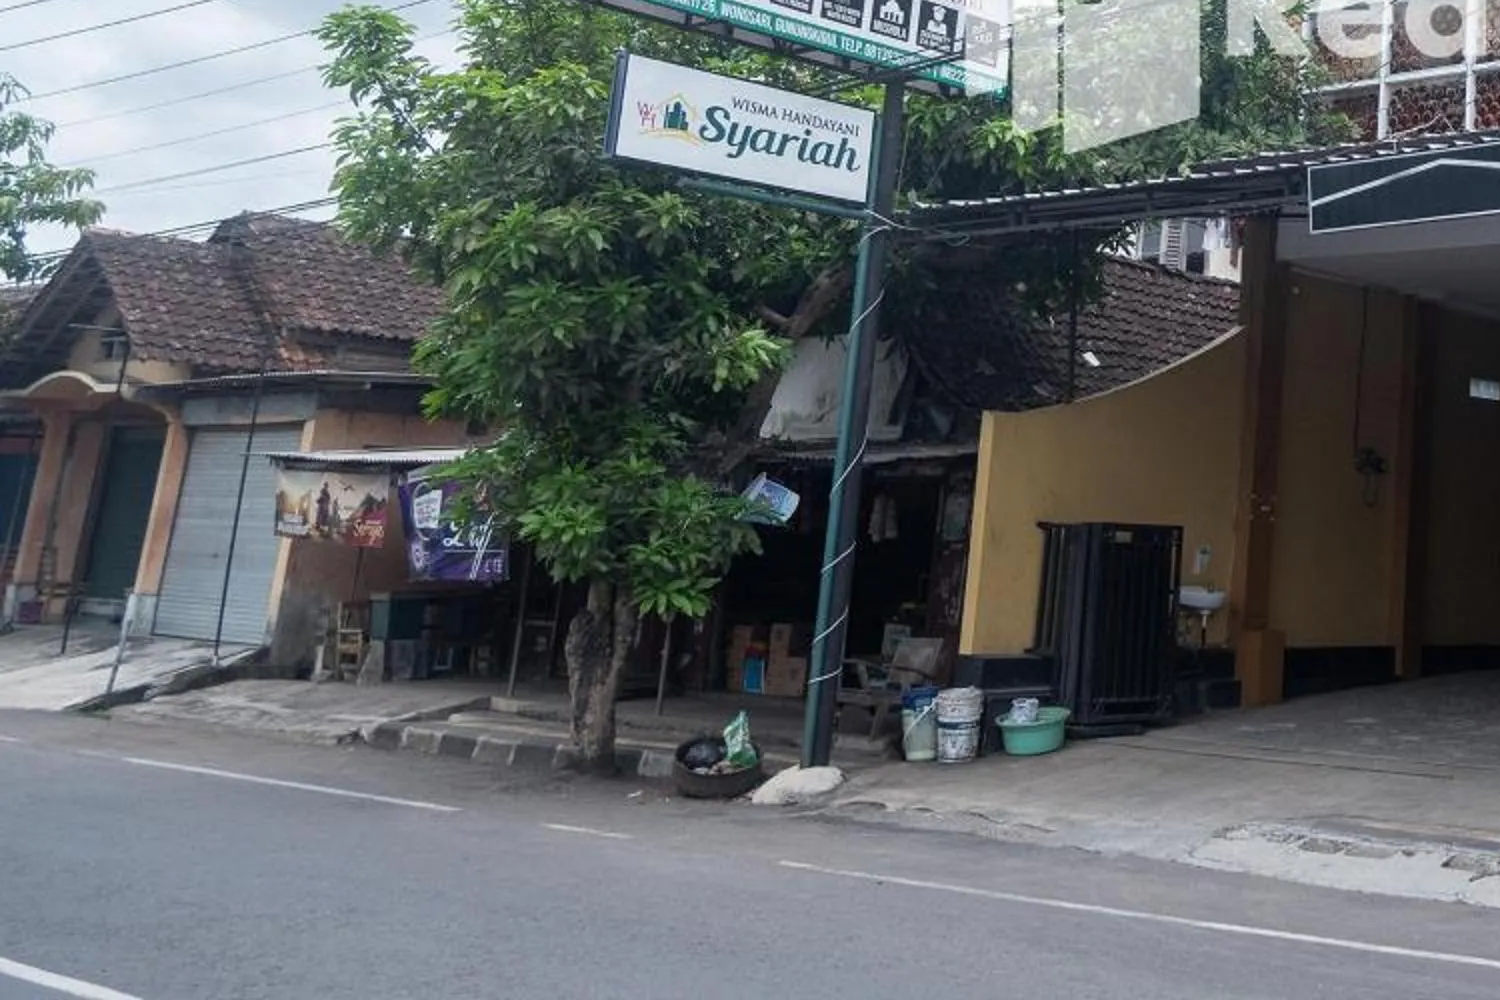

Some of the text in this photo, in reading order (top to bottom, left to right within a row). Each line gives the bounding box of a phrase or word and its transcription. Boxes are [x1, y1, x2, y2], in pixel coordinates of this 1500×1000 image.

[700, 105, 861, 172] Syariah
[732, 96, 861, 137] WISMA HANDAYANI
